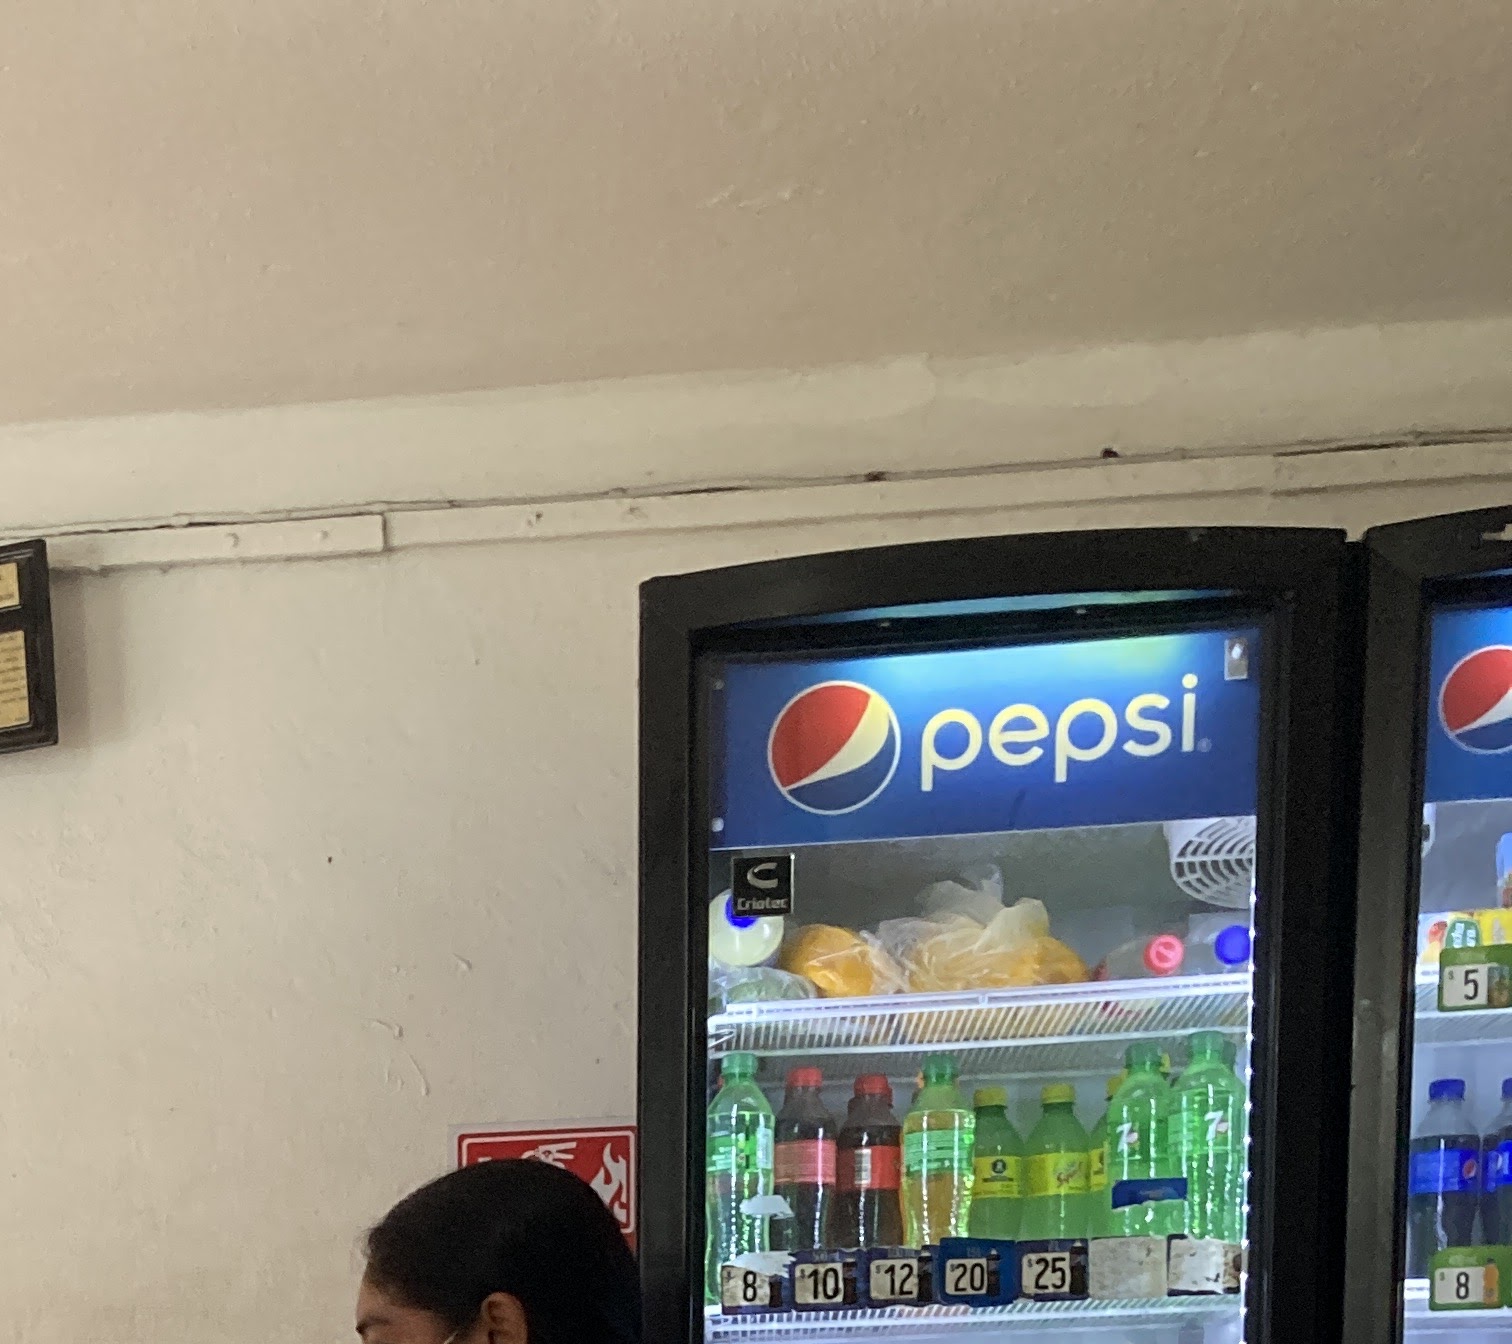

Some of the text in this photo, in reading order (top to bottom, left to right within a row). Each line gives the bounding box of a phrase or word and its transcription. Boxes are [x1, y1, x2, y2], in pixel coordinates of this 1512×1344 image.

[921, 673, 1198, 792] pepsi
[1464, 968, 1480, 1000] 5
[742, 1270, 757, 1302] 8
[1455, 1271, 1470, 1300] 8
